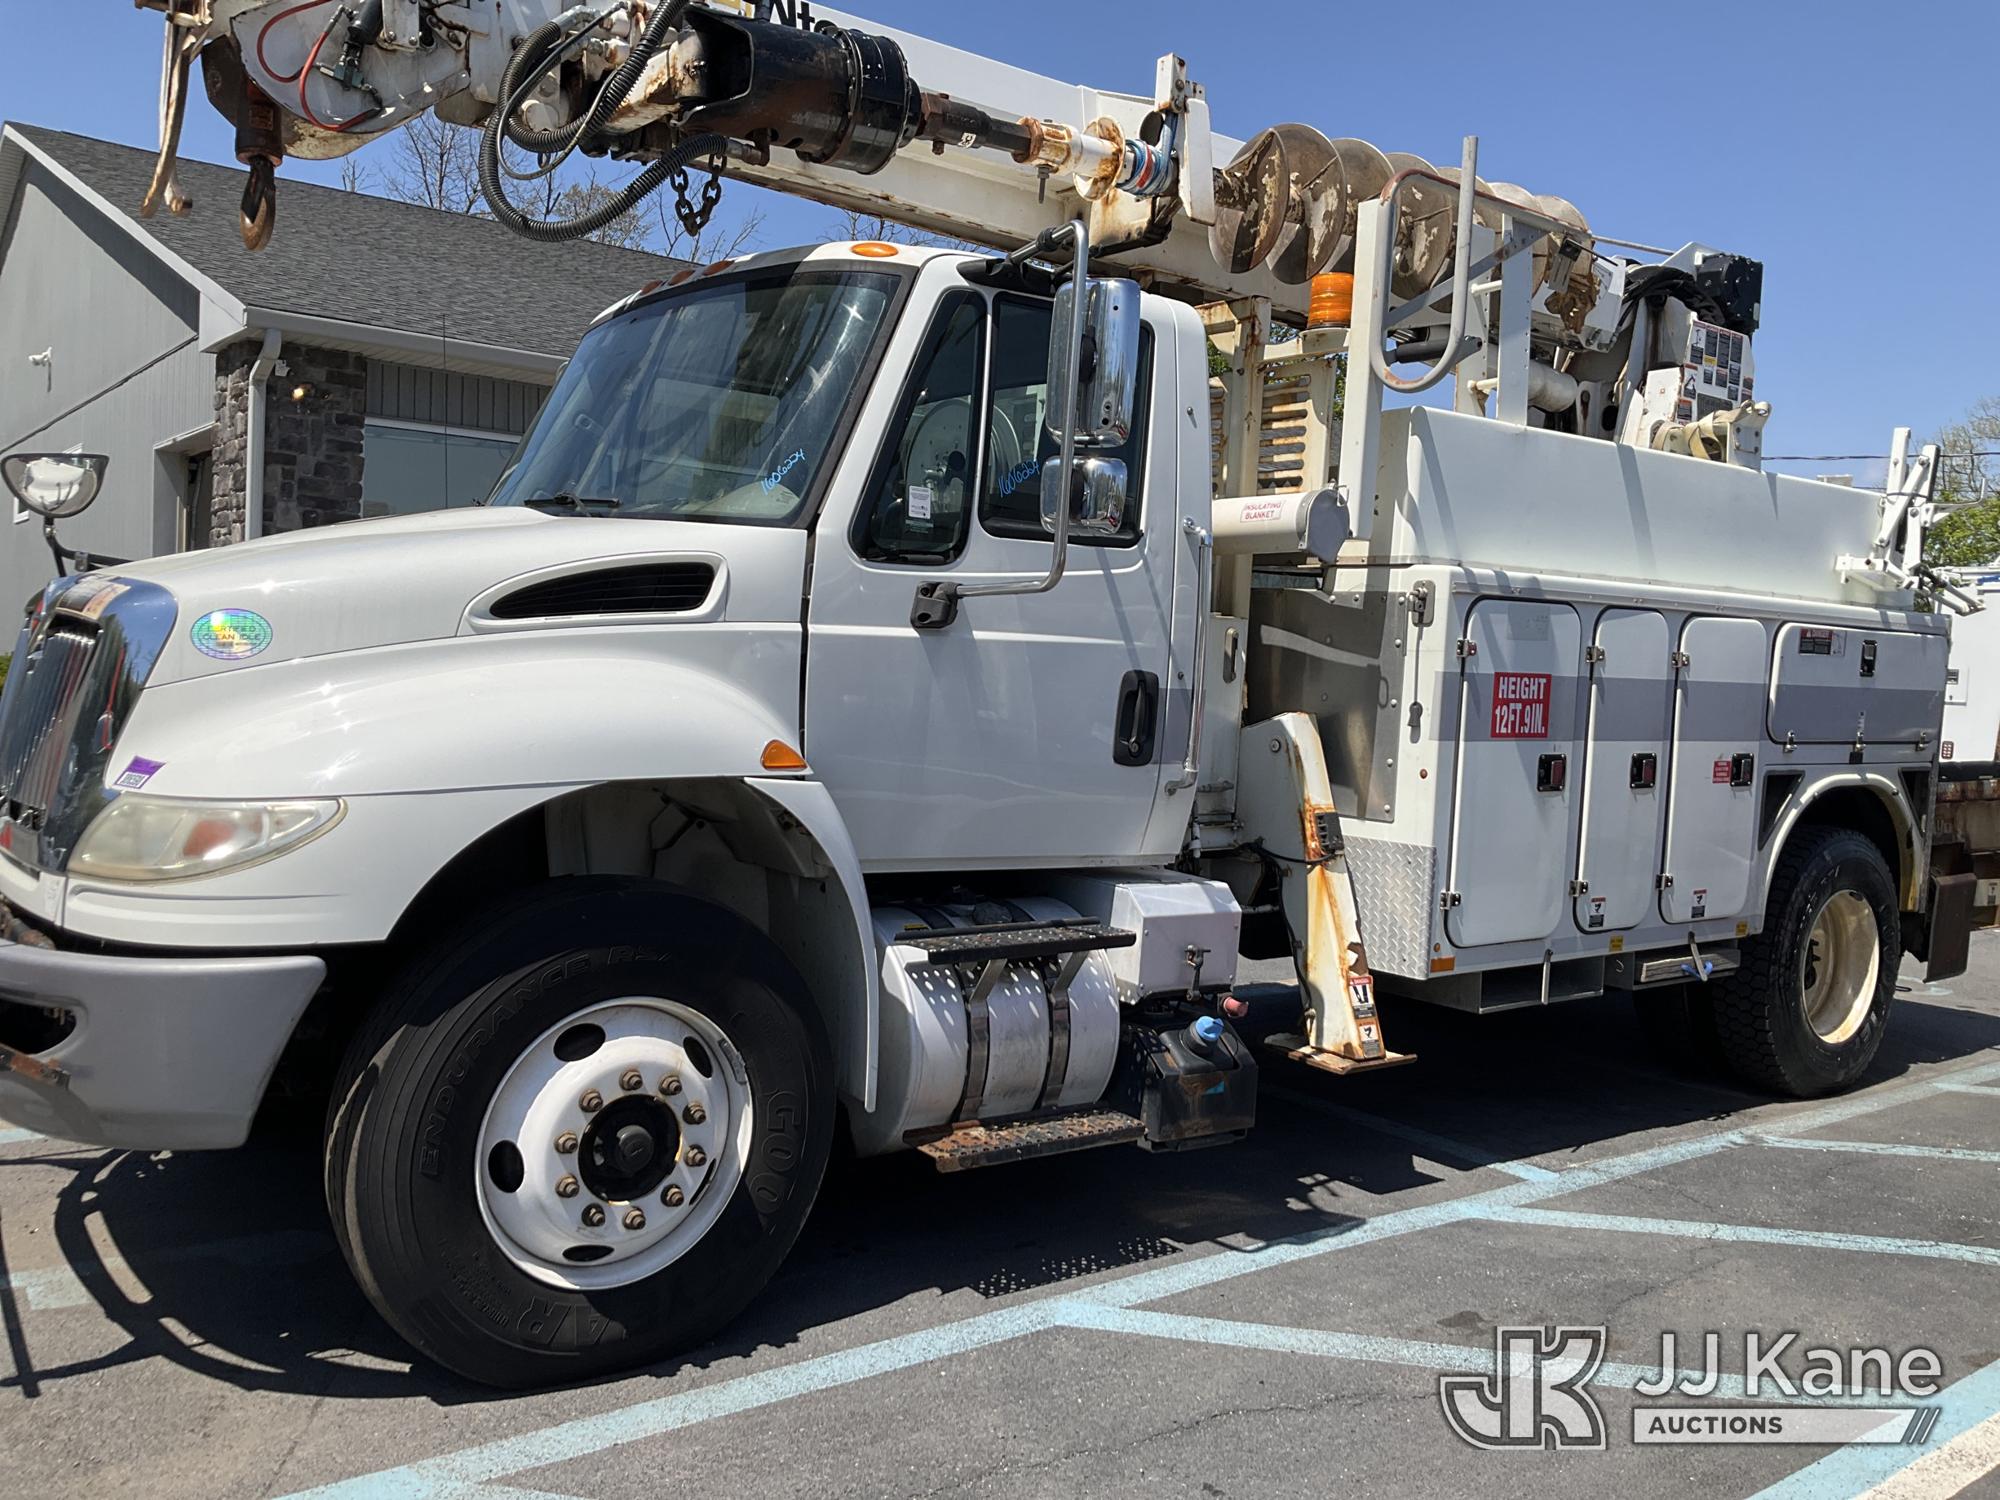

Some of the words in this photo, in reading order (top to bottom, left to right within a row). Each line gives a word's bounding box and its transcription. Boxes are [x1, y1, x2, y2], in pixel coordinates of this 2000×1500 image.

[1245, 510, 1275, 520] BLANKET
[1499, 676, 1547, 699] HEIGHT
[1495, 702, 1545, 734] 12FT.9IN.
